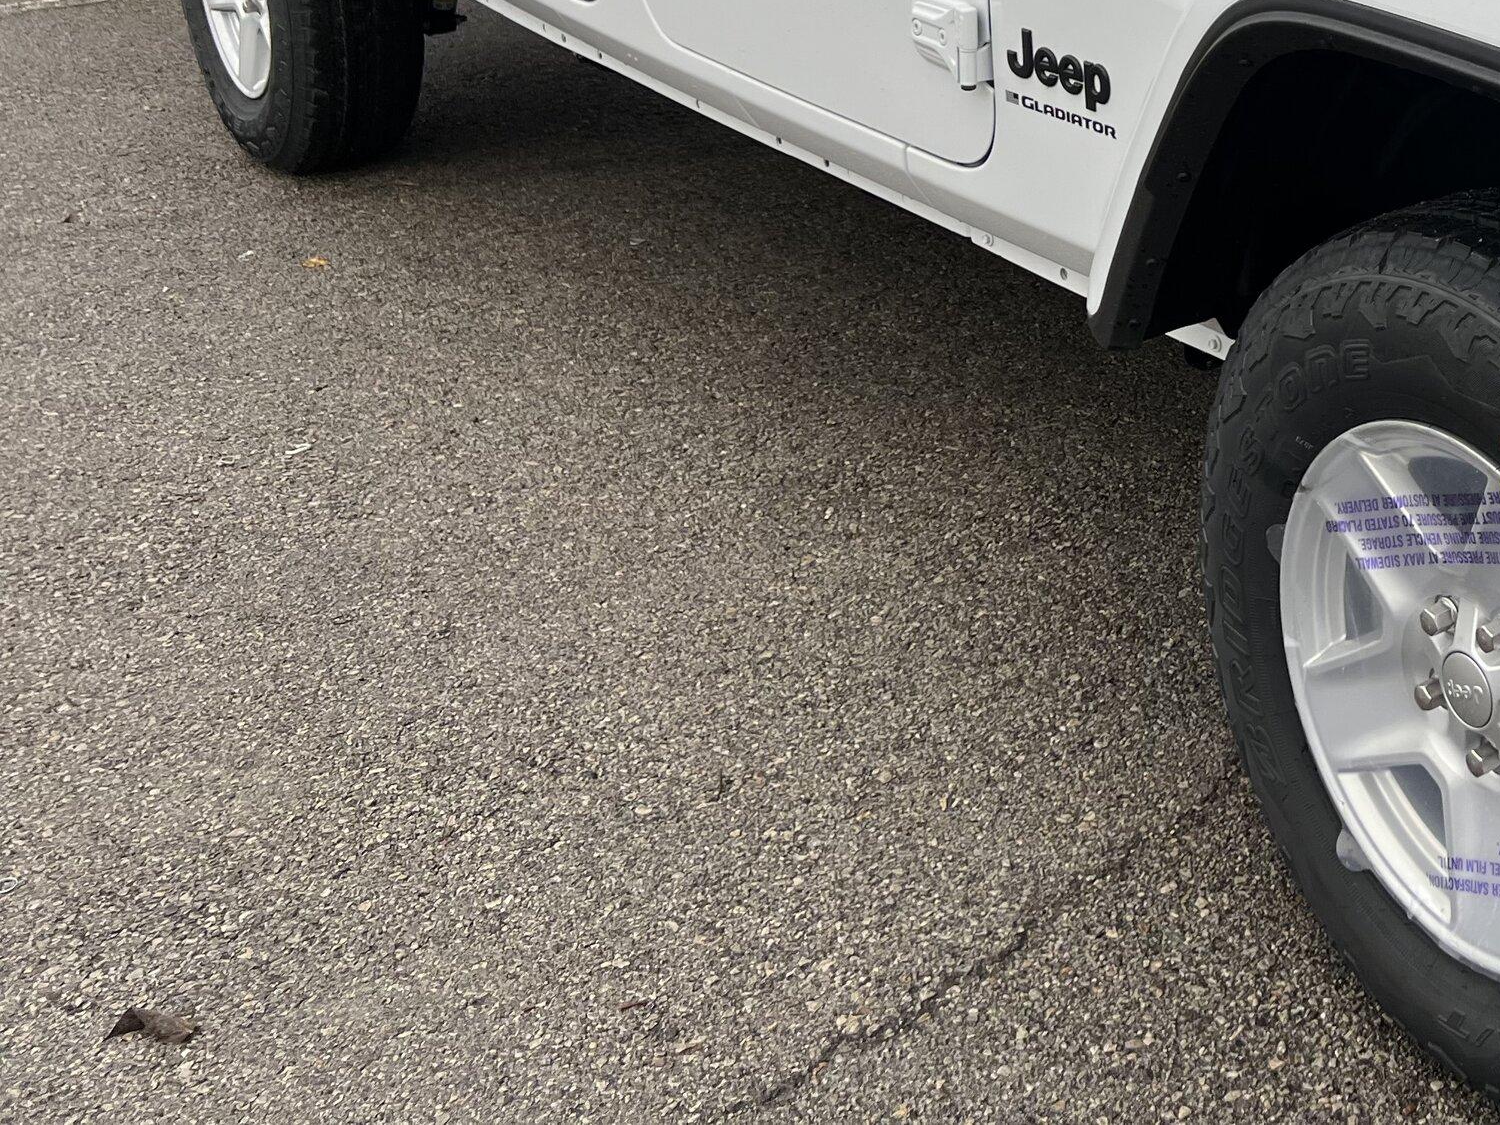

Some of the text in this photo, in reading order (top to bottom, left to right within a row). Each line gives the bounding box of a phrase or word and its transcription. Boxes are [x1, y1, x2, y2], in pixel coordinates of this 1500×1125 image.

[1007, 27, 1111, 112] Jeep
[1021, 95, 1117, 139] GLADIATOR
[1334, 497, 1379, 514] DELIVERY.
[1364, 514, 1400, 531] STATED
[1358, 534, 1404, 551] STORAGE.
[1407, 532, 1442, 547] VEHICLE
[1442, 532, 1477, 546] DURING
[1219, 338, 1371, 787] BRIDGESTONE
[1356, 554, 1400, 571] SIDEWALL
[1404, 553, 1425, 566] MAX
[1428, 553, 1442, 564] AT
[1443, 551, 1485, 565] PRESSURE
[1447, 679, 1483, 704] Jeep
[1439, 856, 1463, 872] UNTIL
[1466, 859, 1487, 874] FILM
